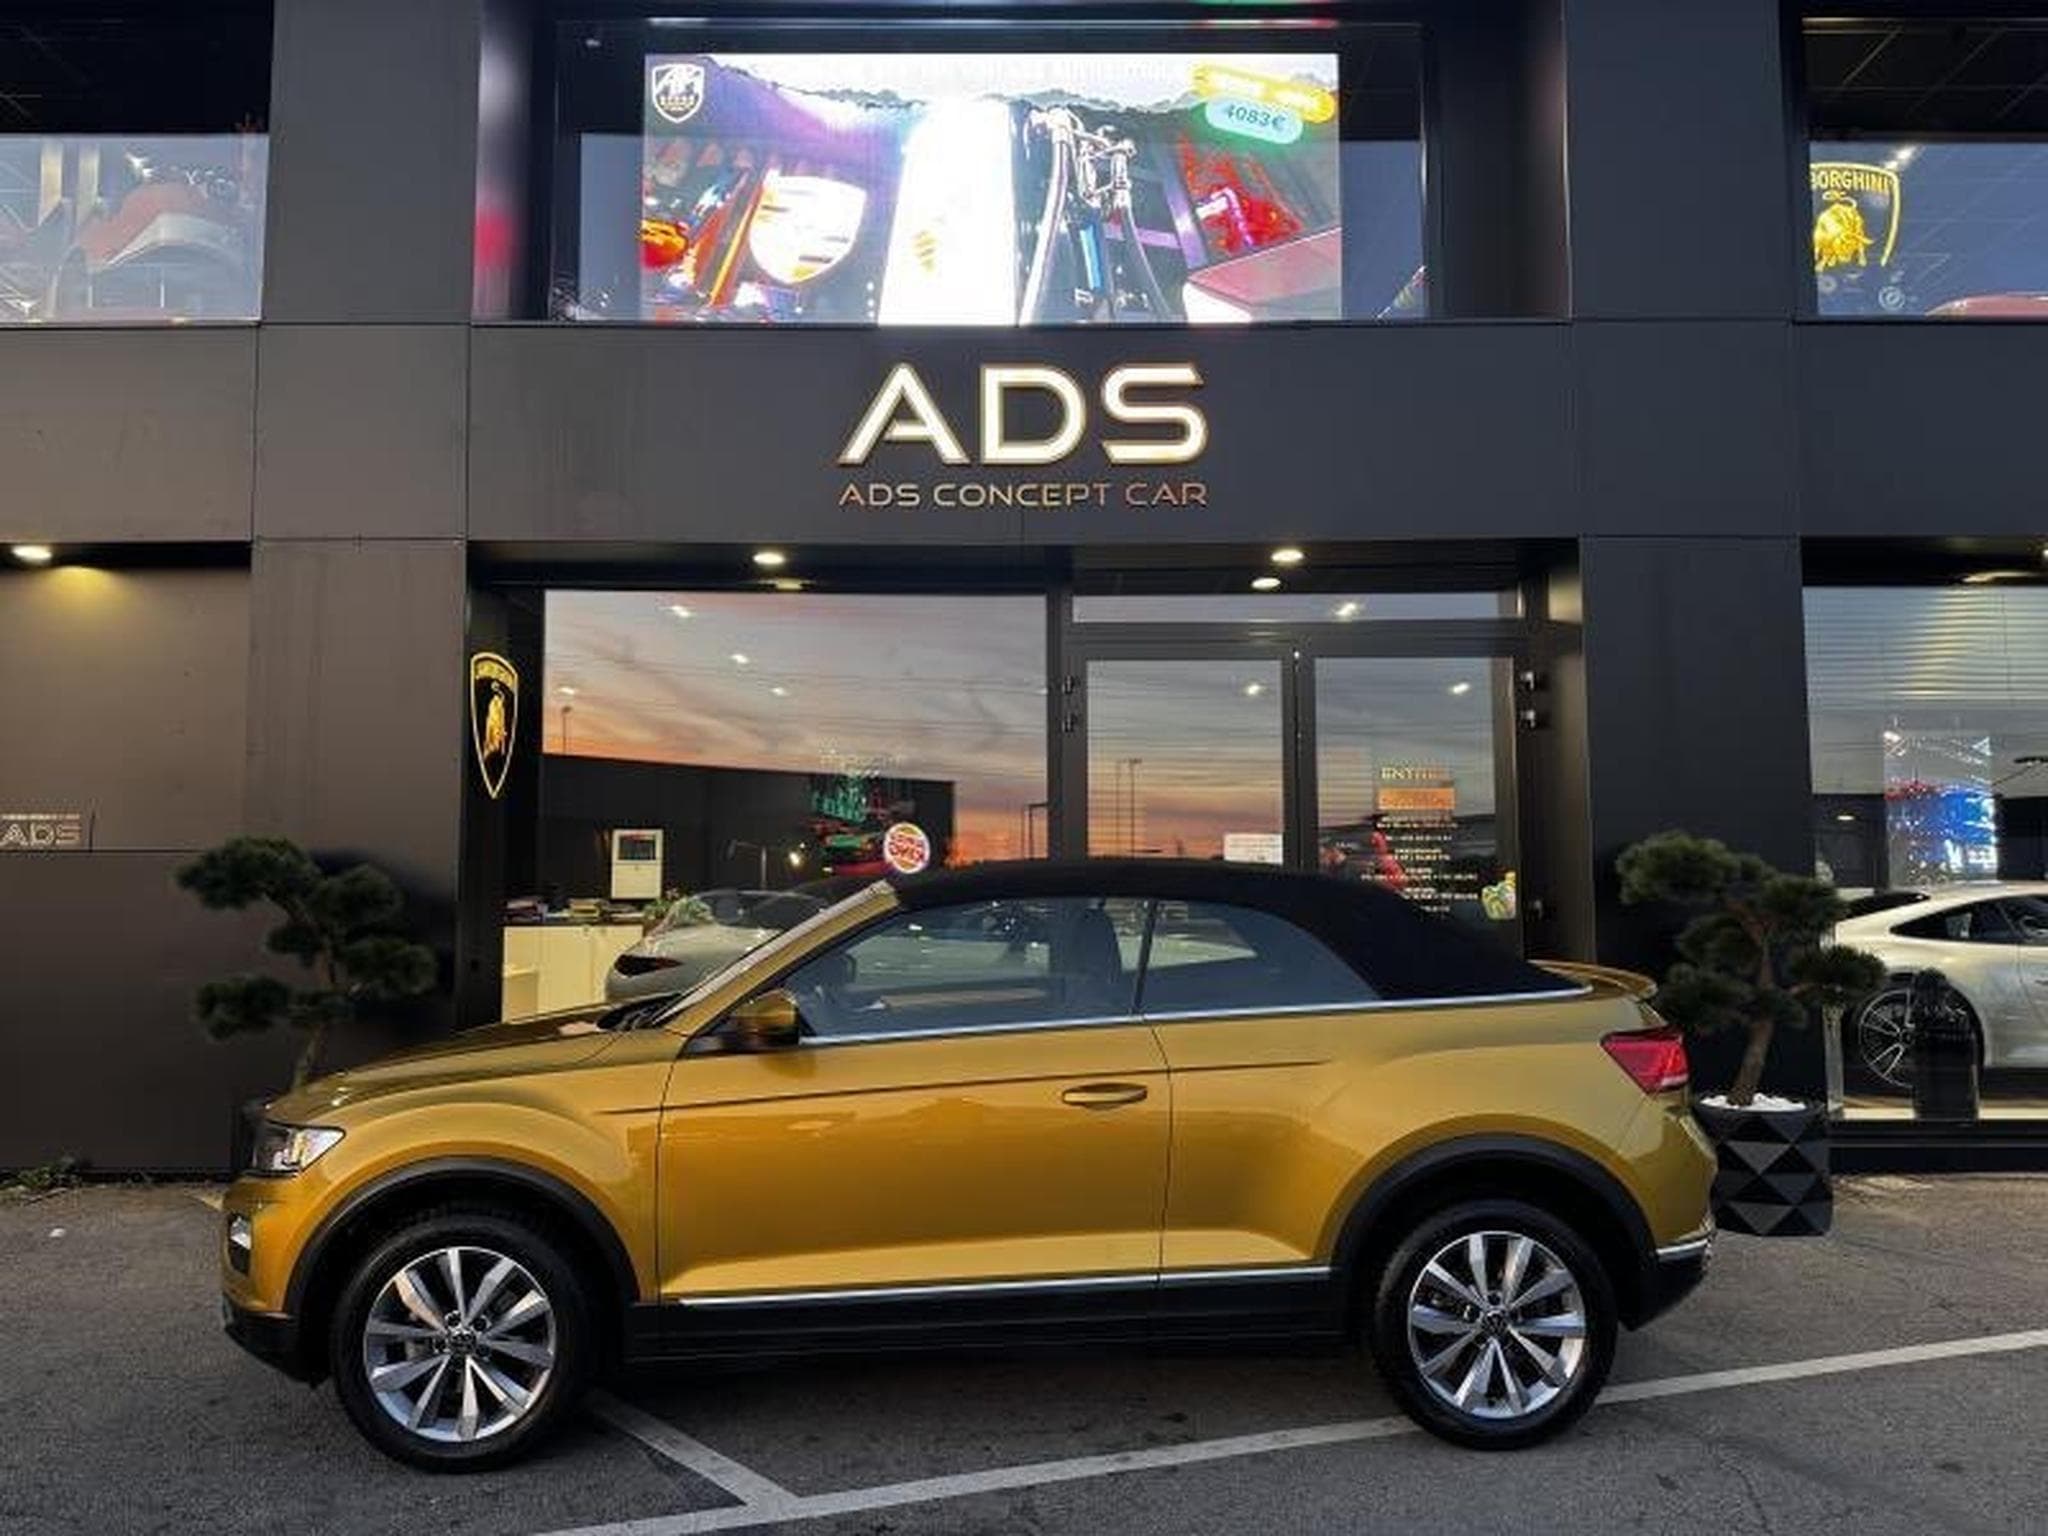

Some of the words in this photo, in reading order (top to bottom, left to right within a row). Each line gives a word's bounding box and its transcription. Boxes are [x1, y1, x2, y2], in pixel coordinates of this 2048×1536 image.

[836, 362, 1209, 466] ADS
[838, 482, 920, 507] ADS
[932, 482, 1112, 507] CONCEPT
[1125, 482, 1208, 506] CAR
[0, 823, 81, 846] ADS
